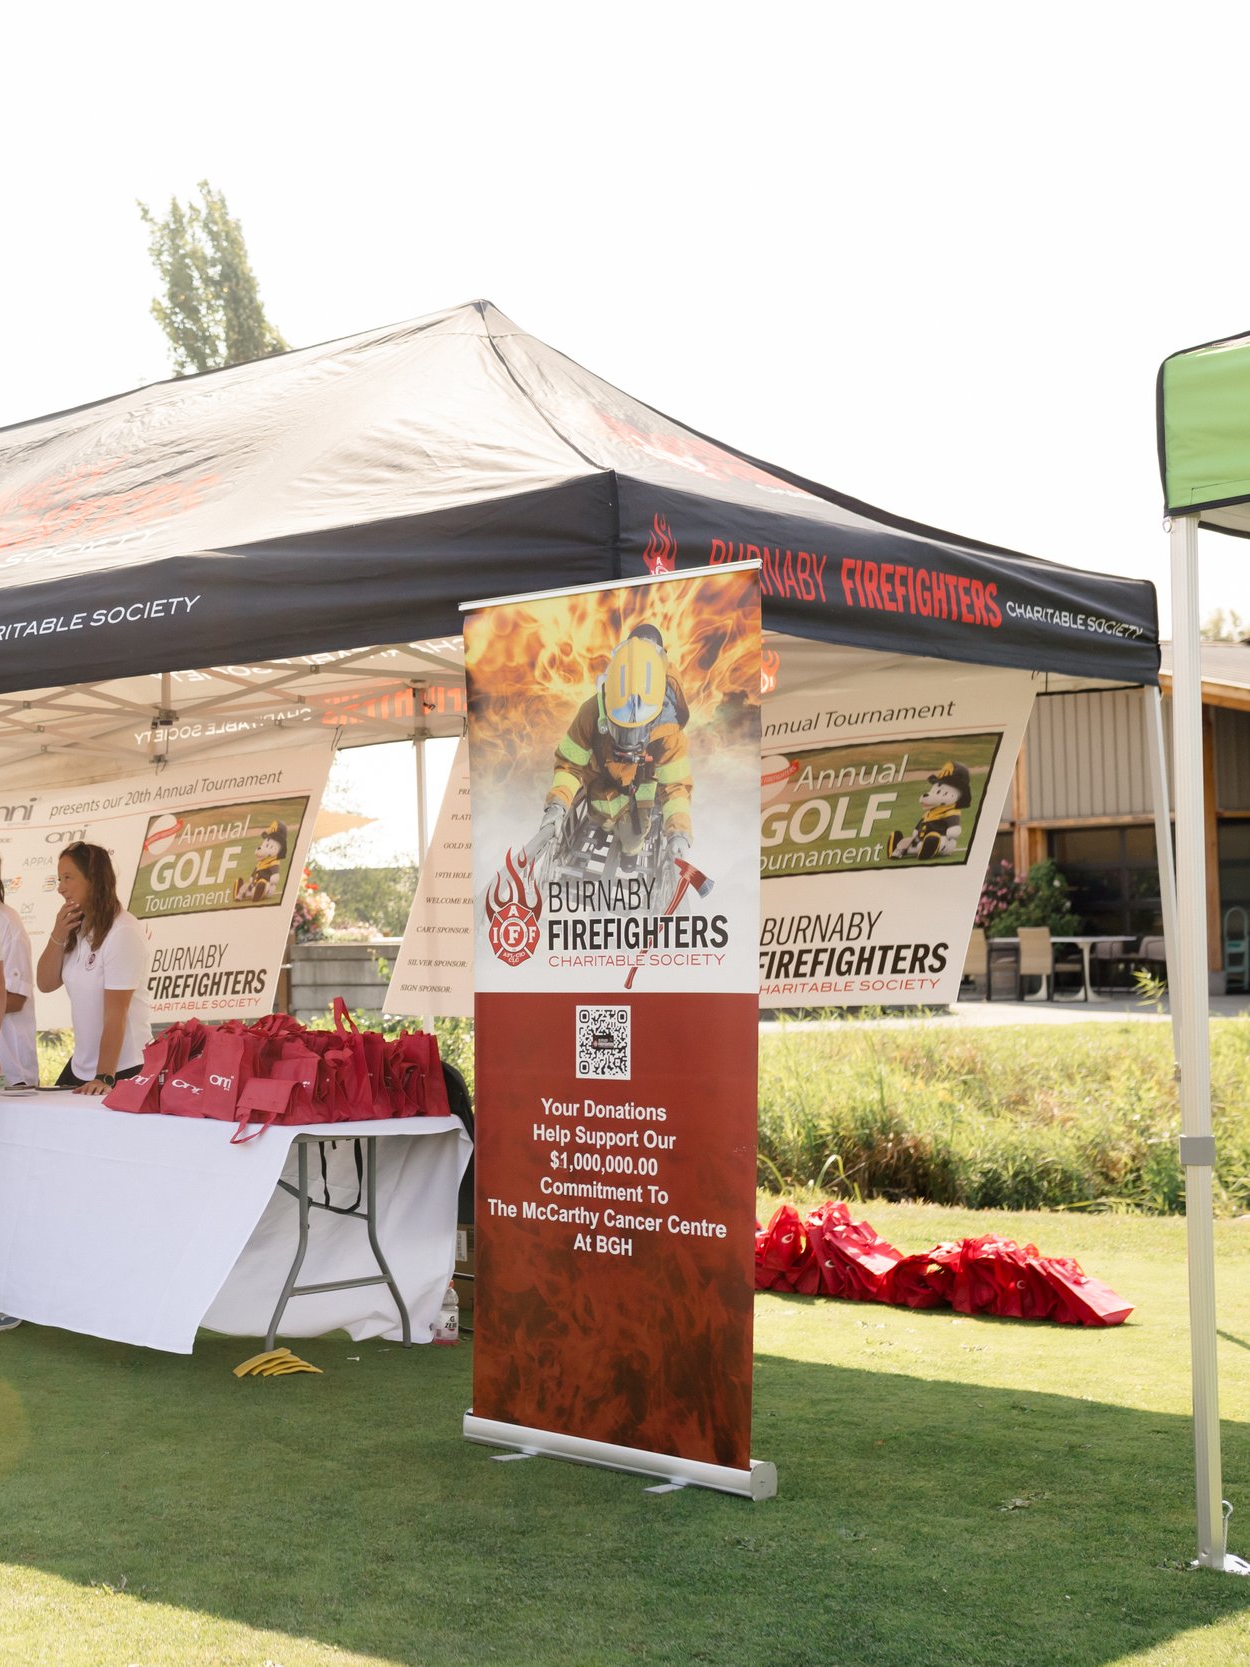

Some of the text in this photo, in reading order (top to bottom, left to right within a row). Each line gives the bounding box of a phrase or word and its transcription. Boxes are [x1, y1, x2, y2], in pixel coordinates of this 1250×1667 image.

[90, 594, 201, 627] SOCIETY
[840, 558, 1003, 628] FIREFIGHTERS
[1006, 600, 1085, 630] CHARITABLE
[1086, 616, 1144, 639] SOCIETY
[761, 700, 956, 738] nnual Tournament
[794, 754, 909, 793] Annual
[49, 799, 100, 819] presents
[102, 793, 124, 810] our
[125, 789, 152, 807] 20th
[153, 780, 198, 802] Annual
[202, 769, 284, 792] Tournament
[178, 814, 251, 846] Annual
[760, 792, 897, 848] GOLF
[443, 842, 464, 850] GOLD
[760, 842, 884, 871] ournament
[150, 846, 243, 892] GOLF
[145, 887, 231, 912] Tournament
[425, 896, 461, 905] WELCOME
[548, 877, 656, 913] BURNABY
[508, 905, 520, 917] A
[416, 926, 435, 934] CART
[548, 914, 729, 951] FIREFIGHTERS
[760, 911, 883, 946] BURNABY
[151, 943, 229, 973] BURNABY
[407, 959, 468, 968] SILVER SPONSOR:
[548, 953, 726, 968] CHARITABLE SOCIETY
[400, 984, 452, 993] SIGN SPONSOR:
[759, 978, 942, 995] HARITABLE SOCIETY
[150, 998, 262, 1013] HARITABLE SOCIETY
[541, 1098, 667, 1122] Your Donations
[533, 1124, 676, 1150] Help Support Our
[550, 1150, 659, 1177] $1,000,000.00
[540, 1176, 669, 1205] Commitment To
[487, 1198, 727, 1239] The McCarthy Cancer Centre
[574, 1233, 633, 1257] At BGH
